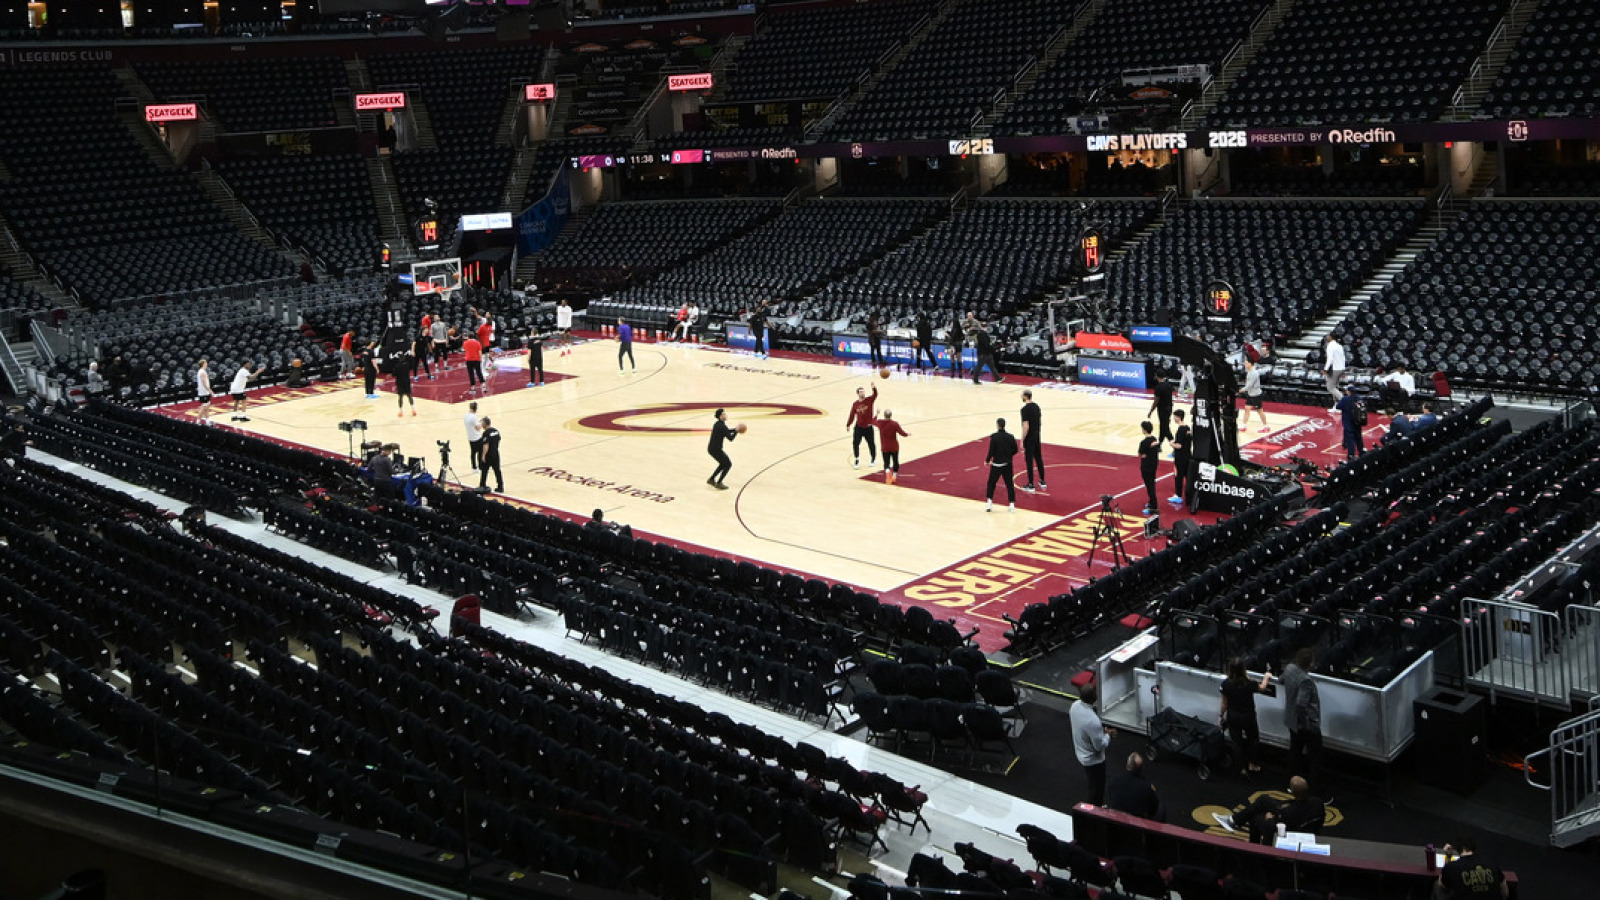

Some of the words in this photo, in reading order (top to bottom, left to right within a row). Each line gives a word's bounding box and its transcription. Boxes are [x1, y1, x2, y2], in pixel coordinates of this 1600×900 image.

[19, 52, 77, 62] LEGENDS
[80, 51, 113, 61] CLUB
[670, 76, 709, 87] SEATGEEK
[358, 96, 401, 107] SEATGEEK
[148, 106, 193, 119] SEATGEEK
[1086, 135, 1119, 151] CAVS
[1120, 133, 1188, 150] PLAYOFFS
[1208, 131, 1248, 148] 2026
[1250, 133, 1305, 144] PRESENTED
[1310, 132, 1323, 143] BY
[1342, 127, 1396, 144] Redfin
[713, 150, 748, 159] PRESENTED
[768, 147, 797, 159] Redfin
[1215, 299, 1228, 312] 14
[1092, 367, 1109, 377] NBC
[1111, 369, 1140, 380] peacock
[606, 484, 676, 504] Arena
[1193, 480, 1256, 500] coinbase
[903, 510, 1149, 608] CAVALIERS
